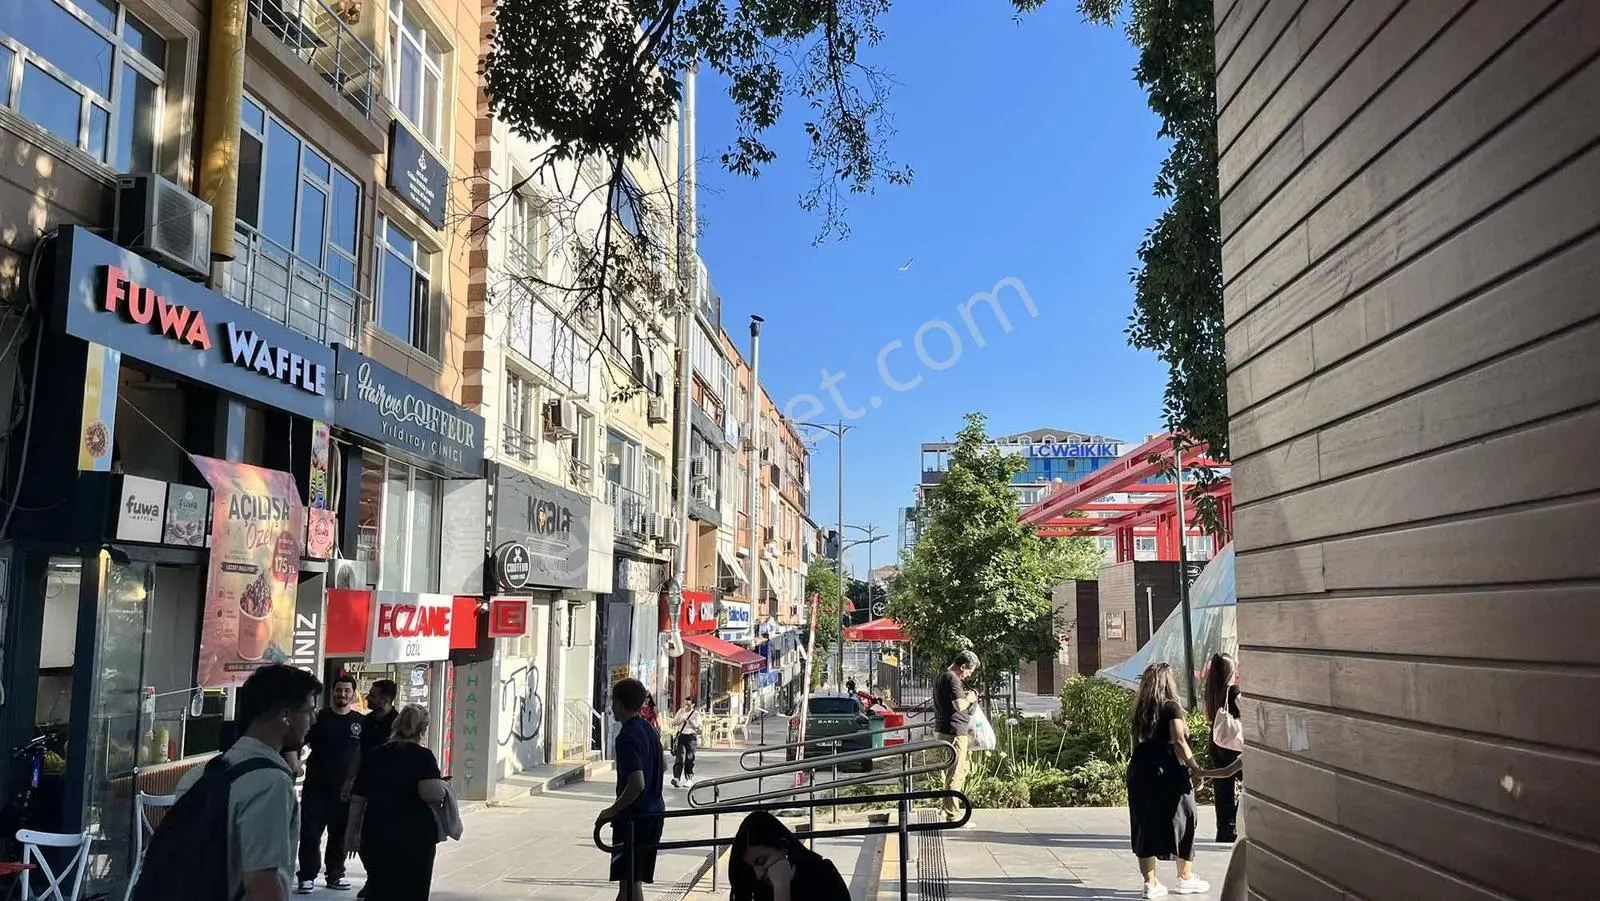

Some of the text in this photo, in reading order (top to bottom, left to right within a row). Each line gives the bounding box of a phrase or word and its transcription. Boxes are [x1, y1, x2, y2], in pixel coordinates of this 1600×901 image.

[103, 264, 326, 397] FUWA WAFFLE
[403, 394, 475, 449] COIFFEUR
[126, 494, 160, 517] fuwa
[227, 493, 291, 528] AÇILIŞA
[246, 516, 274, 550] Özel
[274, 556, 297, 574] 175 TL
[377, 603, 451, 638] ECZANE
[463, 661, 479, 786] PHARMACY
